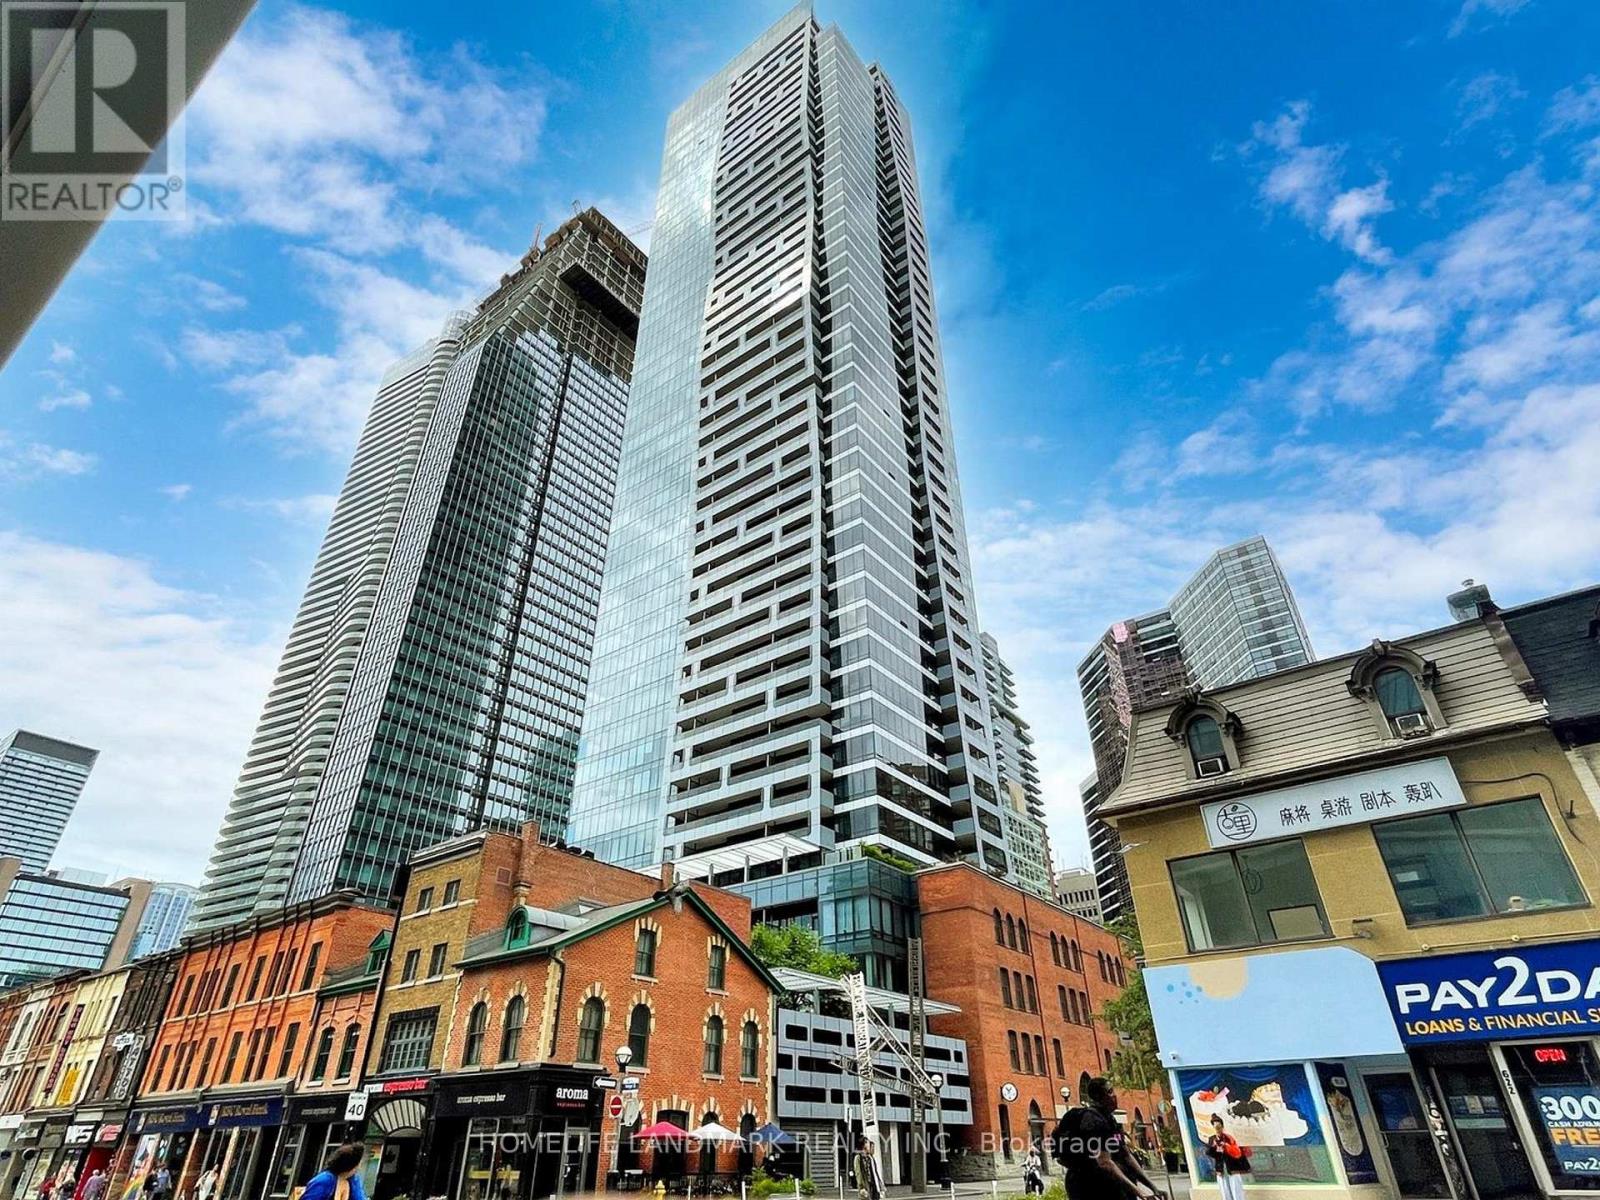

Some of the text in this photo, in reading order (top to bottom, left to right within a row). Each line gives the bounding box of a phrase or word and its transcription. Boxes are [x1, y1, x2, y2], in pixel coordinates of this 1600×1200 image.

[1279, 781, 1443, 827] 麻将 桌游 剧本 轰趴
[1405, 1008, 1600, 1036] LOANS & FINANCIAL S
[1534, 1049, 1567, 1062] OPEN
[1502, 1070, 1516, 1095] 622
[556, 1087, 588, 1100] aroma
[348, 1104, 364, 1116] 40
[1550, 1127, 1600, 1145] FRE
[1564, 1157, 1600, 1170] PAY2
